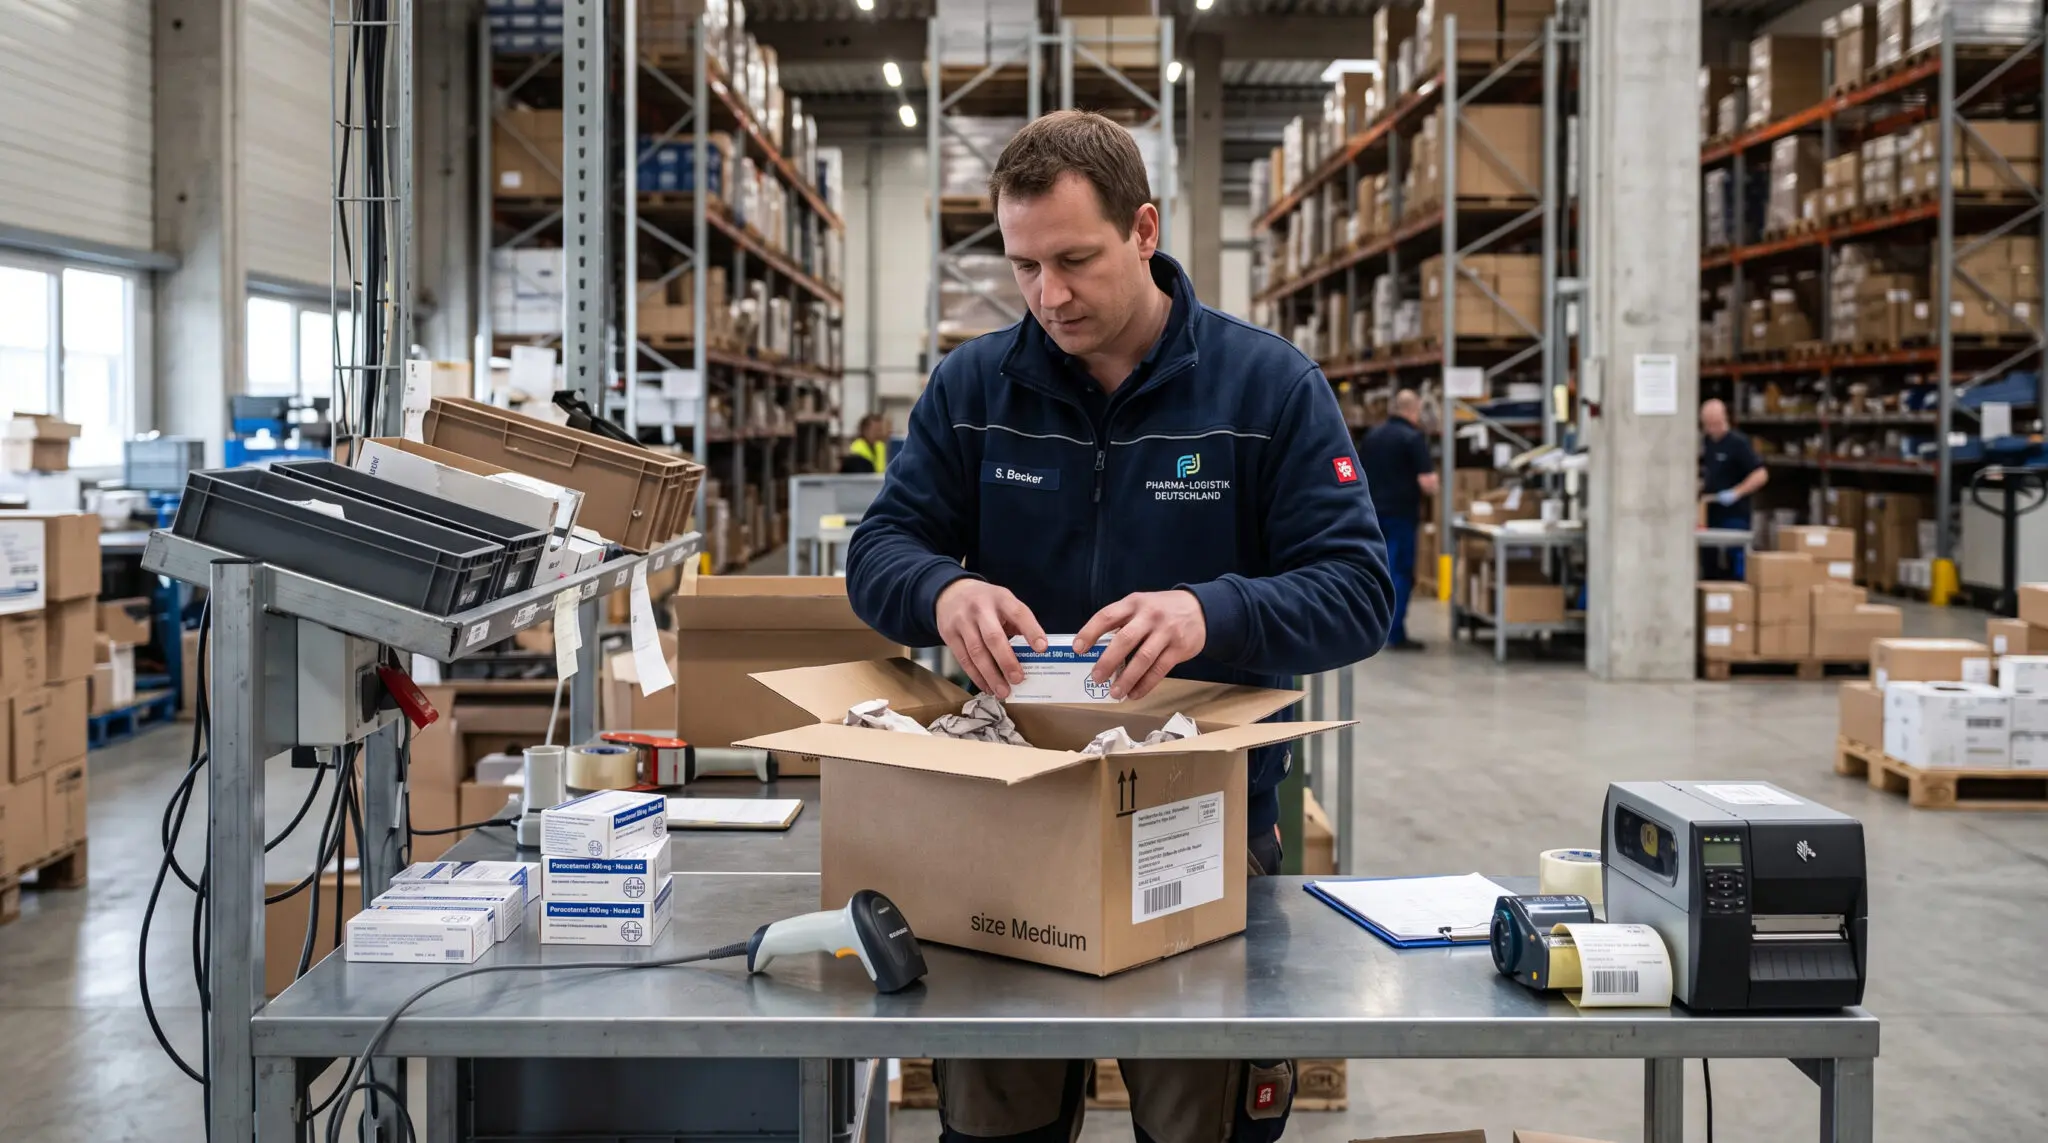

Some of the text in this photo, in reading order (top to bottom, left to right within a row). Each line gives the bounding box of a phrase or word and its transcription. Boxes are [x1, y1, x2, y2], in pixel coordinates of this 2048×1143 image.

[995, 468, 1043, 484] S. Becker
[1146, 480, 1230, 490] PHARMA-LOGISTIK
[1155, 491, 1221, 500] DEUTSCHLAND
[971, 912, 1087, 951] size Medium
